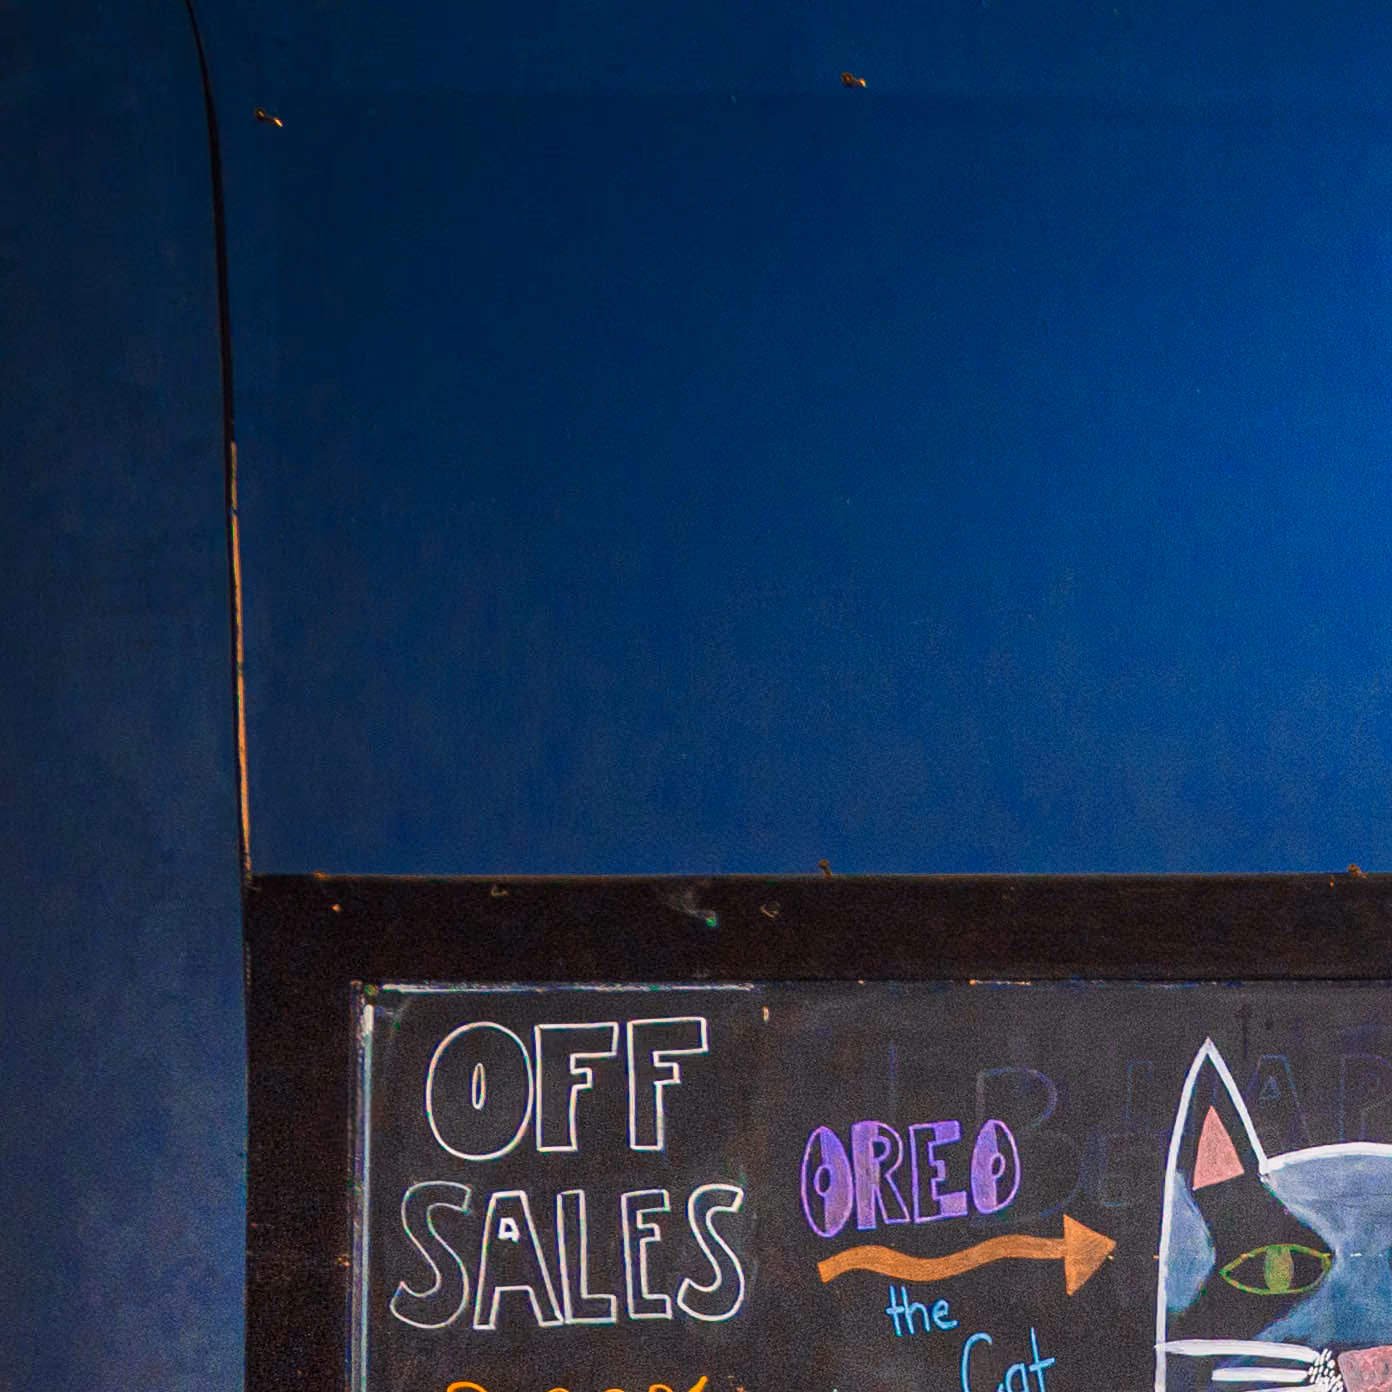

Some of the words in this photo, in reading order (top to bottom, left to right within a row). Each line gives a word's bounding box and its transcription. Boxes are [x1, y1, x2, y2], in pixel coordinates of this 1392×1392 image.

[426, 1017, 708, 1160] OFF
[801, 1119, 1021, 1239] OREO
[390, 1181, 745, 1330] SALES
[886, 1286, 958, 1336] the
